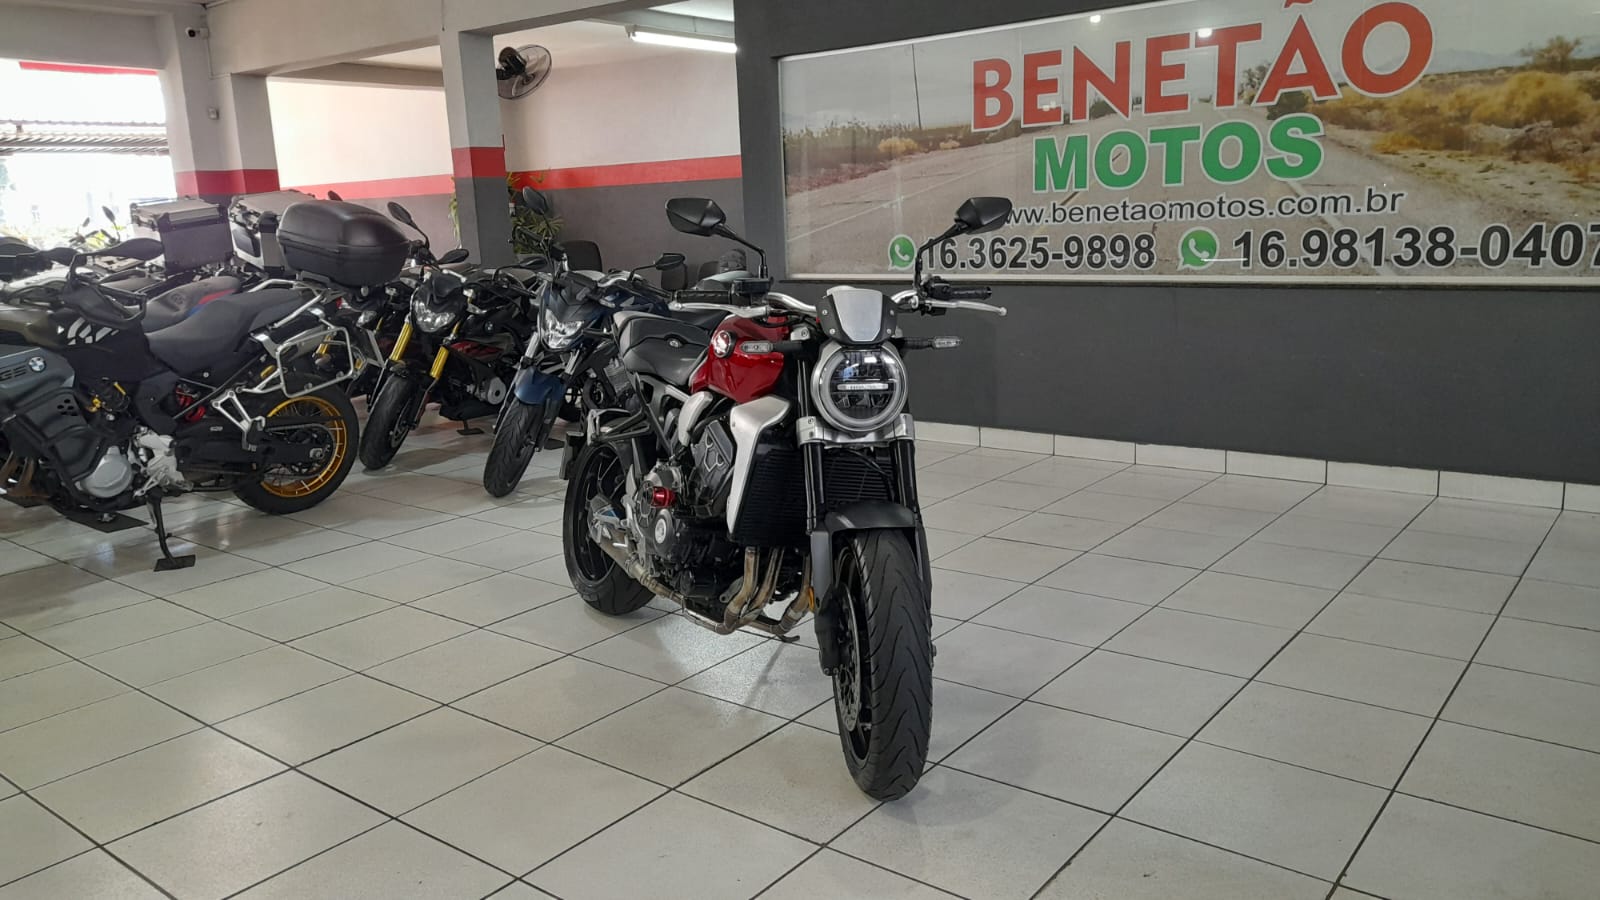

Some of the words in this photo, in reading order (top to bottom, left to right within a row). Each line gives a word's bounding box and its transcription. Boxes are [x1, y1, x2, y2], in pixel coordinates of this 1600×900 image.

[972, 0, 1433, 131] BENETÃO
[1034, 115, 1322, 191] MOTOS
[1005, 188, 1404, 224] ww.benetaomotos.com.br
[928, 235, 1155, 269] 16.3625-9898
